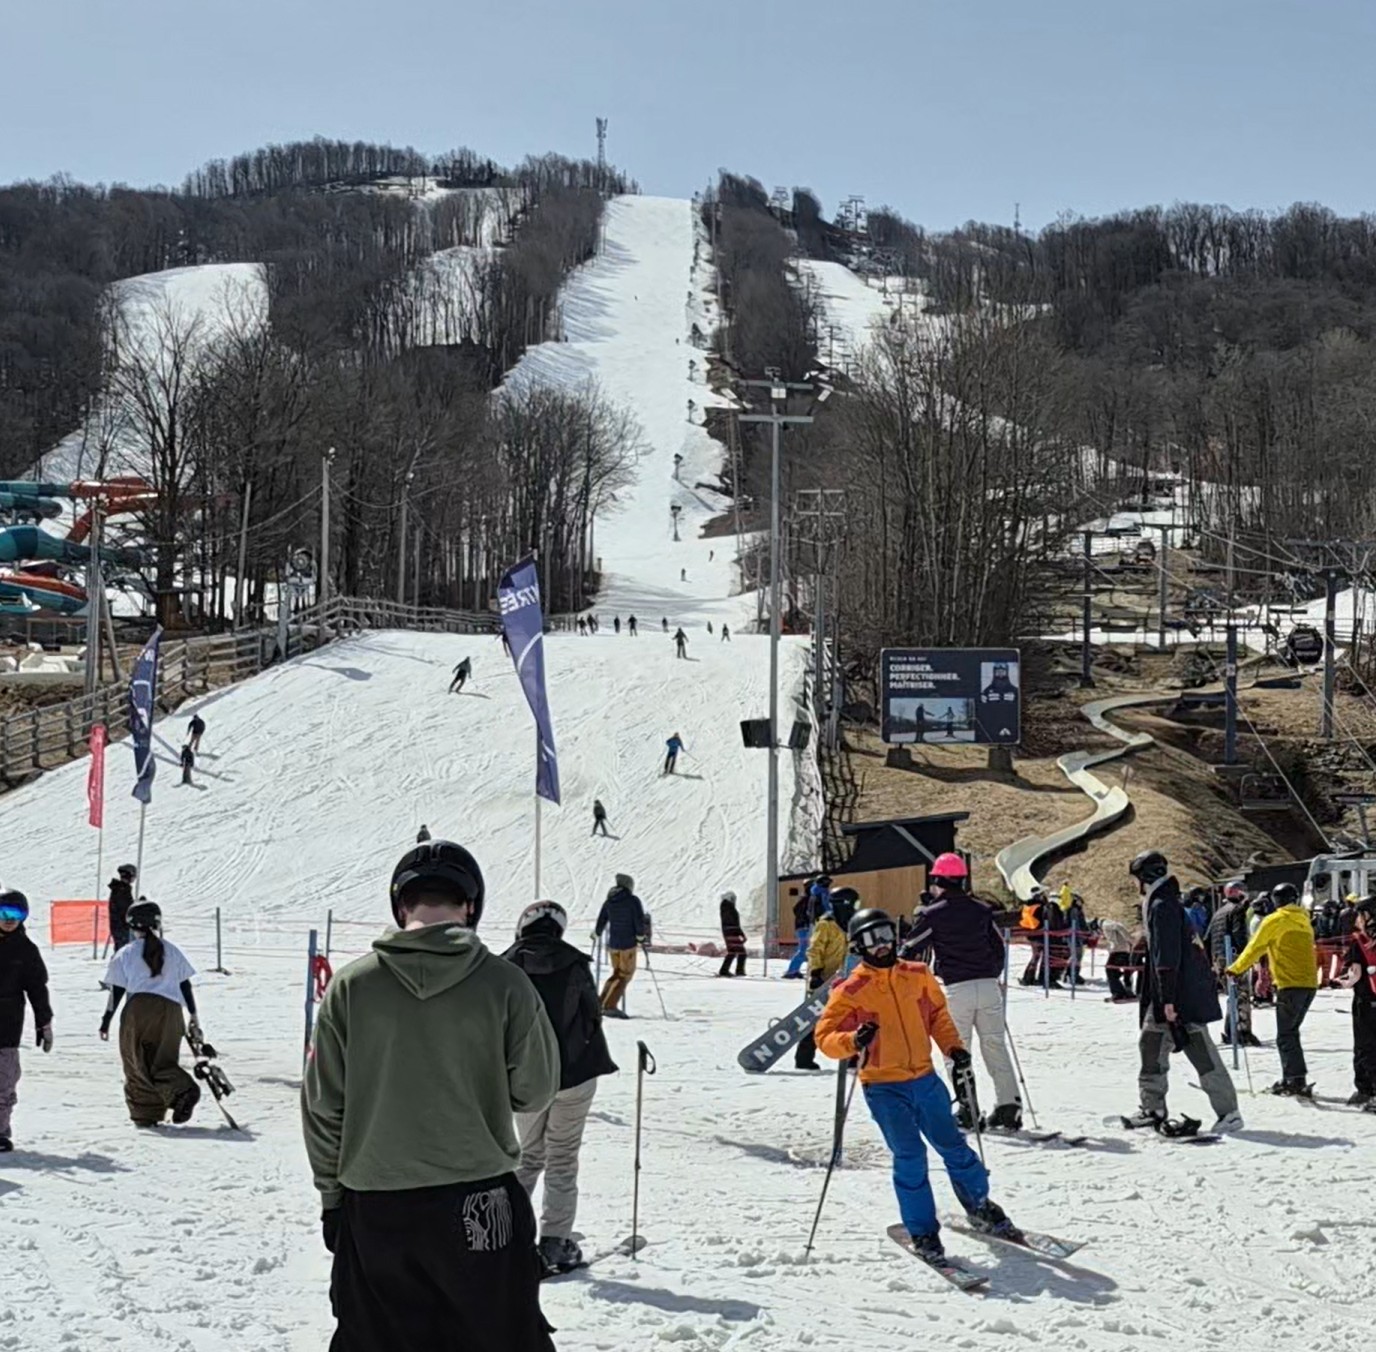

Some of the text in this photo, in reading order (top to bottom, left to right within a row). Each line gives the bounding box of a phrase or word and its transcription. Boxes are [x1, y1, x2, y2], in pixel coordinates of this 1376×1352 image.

[889, 664, 934, 672] CORRIGER.
[889, 672, 961, 680] PERFECTIONNER.
[889, 679, 937, 689] MAÎTRISER.
[752, 999, 826, 1064] RTON
